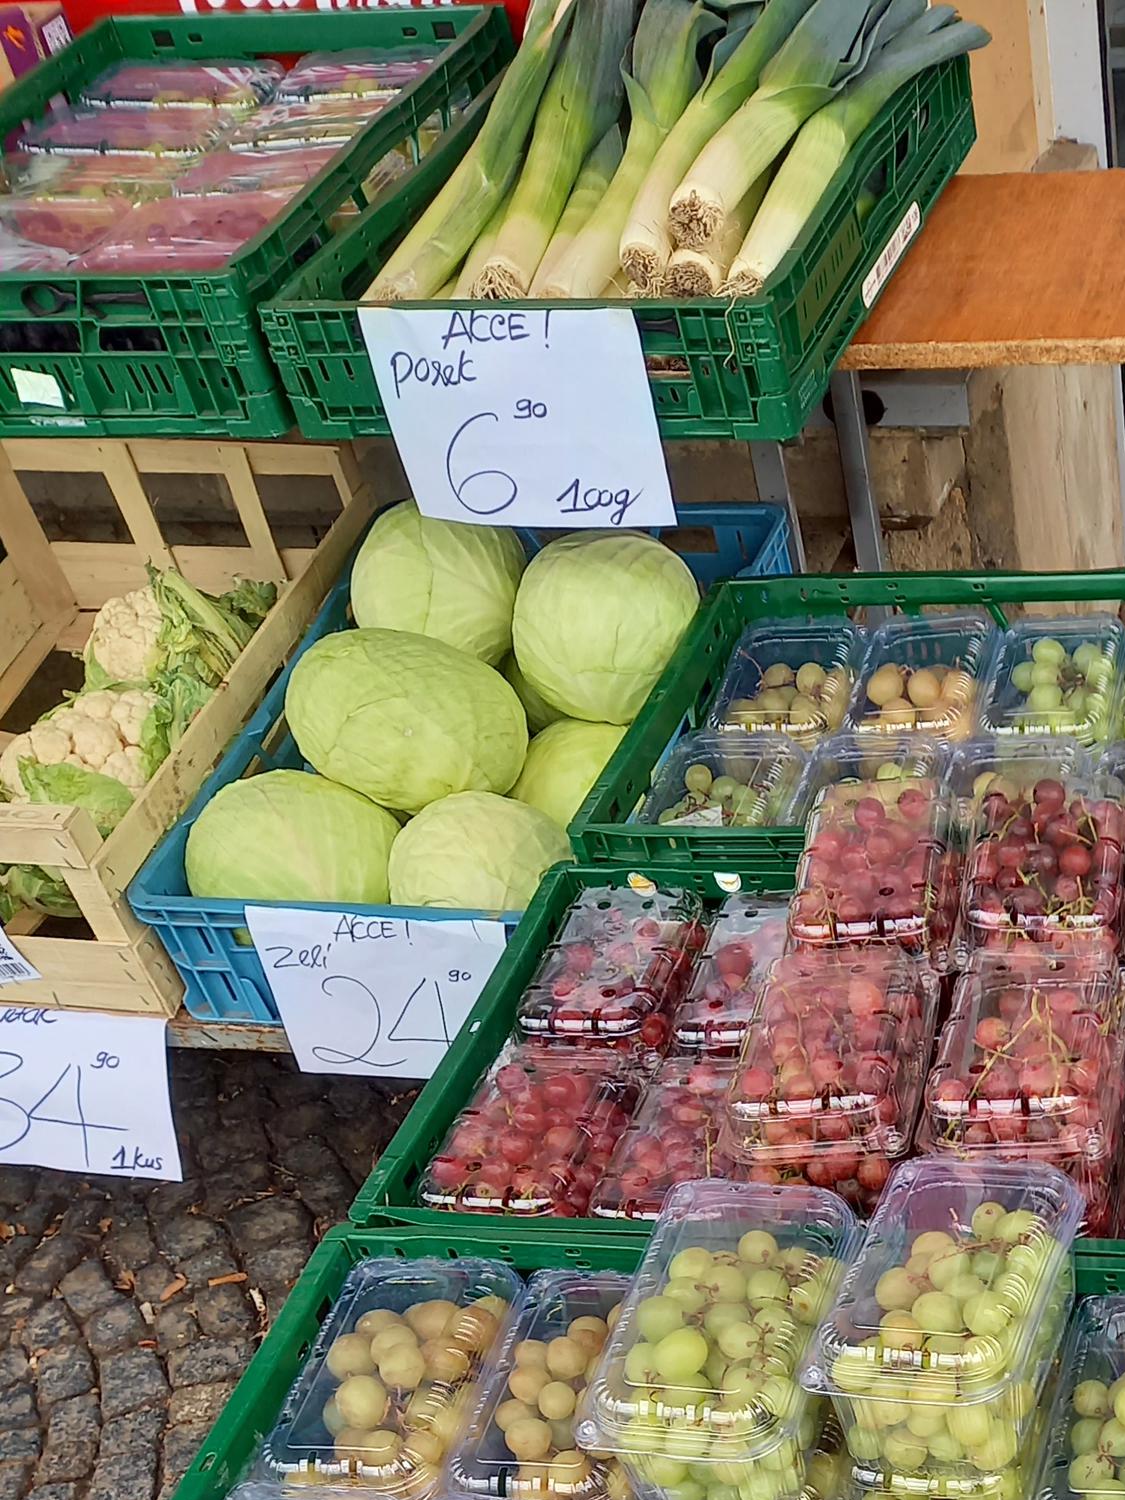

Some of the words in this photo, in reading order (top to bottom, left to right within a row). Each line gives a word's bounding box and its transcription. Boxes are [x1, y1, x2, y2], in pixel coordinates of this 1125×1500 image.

[446, 412, 518, 515] 6
[513, 398, 548, 419] 90
[556, 478, 645, 526] 100g
[312, 975, 455, 1068] 24
[447, 968, 472, 983] 90
[90, 1050, 121, 1069] 90
